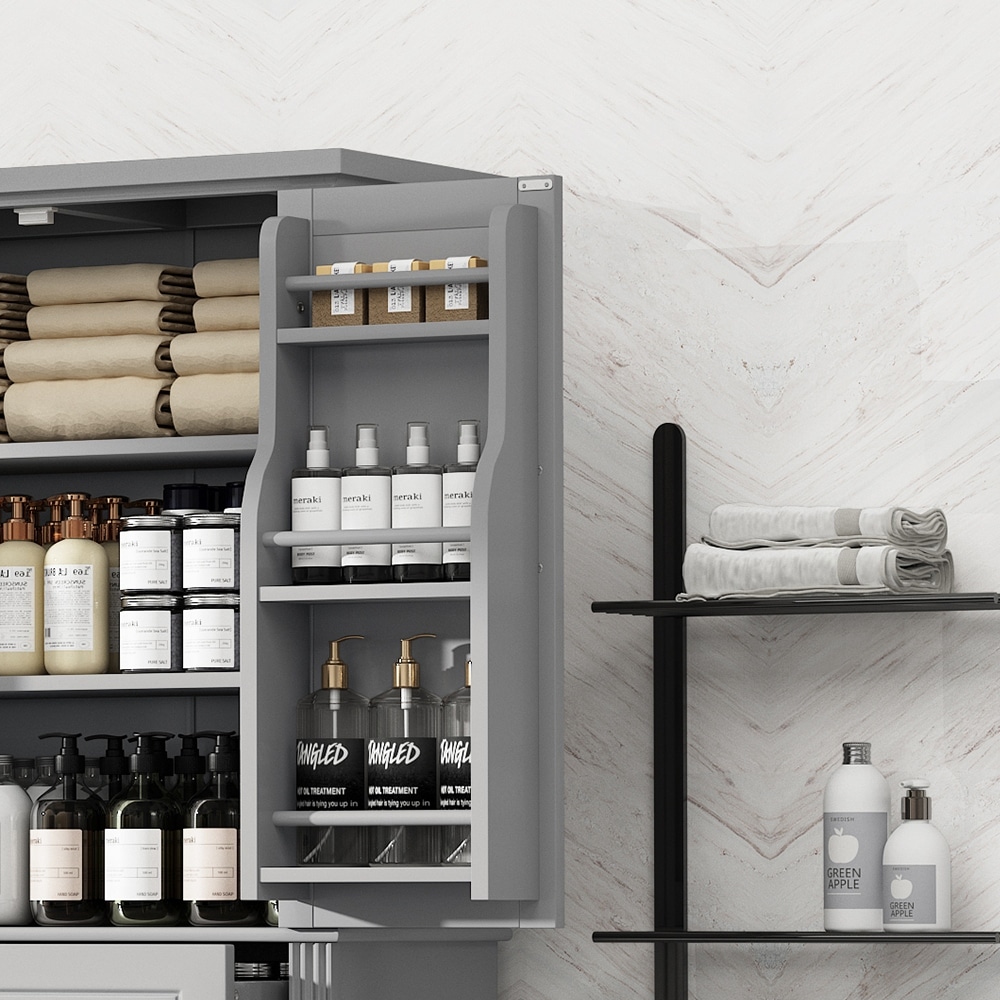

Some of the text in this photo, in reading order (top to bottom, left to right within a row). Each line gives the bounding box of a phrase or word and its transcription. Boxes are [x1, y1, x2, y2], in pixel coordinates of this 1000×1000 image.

[310, 787, 347, 795] TREATMENT
[382, 786, 419, 795] TREATMENT
[454, 785, 471, 794] TREAT
[328, 801, 338, 809] you
[400, 800, 410, 808] you
[411, 800, 420, 808] up
[422, 799, 431, 807] in
[827, 867, 861, 878] GREEN
[828, 879, 860, 889] APPLE
[889, 901, 915, 910] GREEN
[890, 909, 913, 918] APPLE
